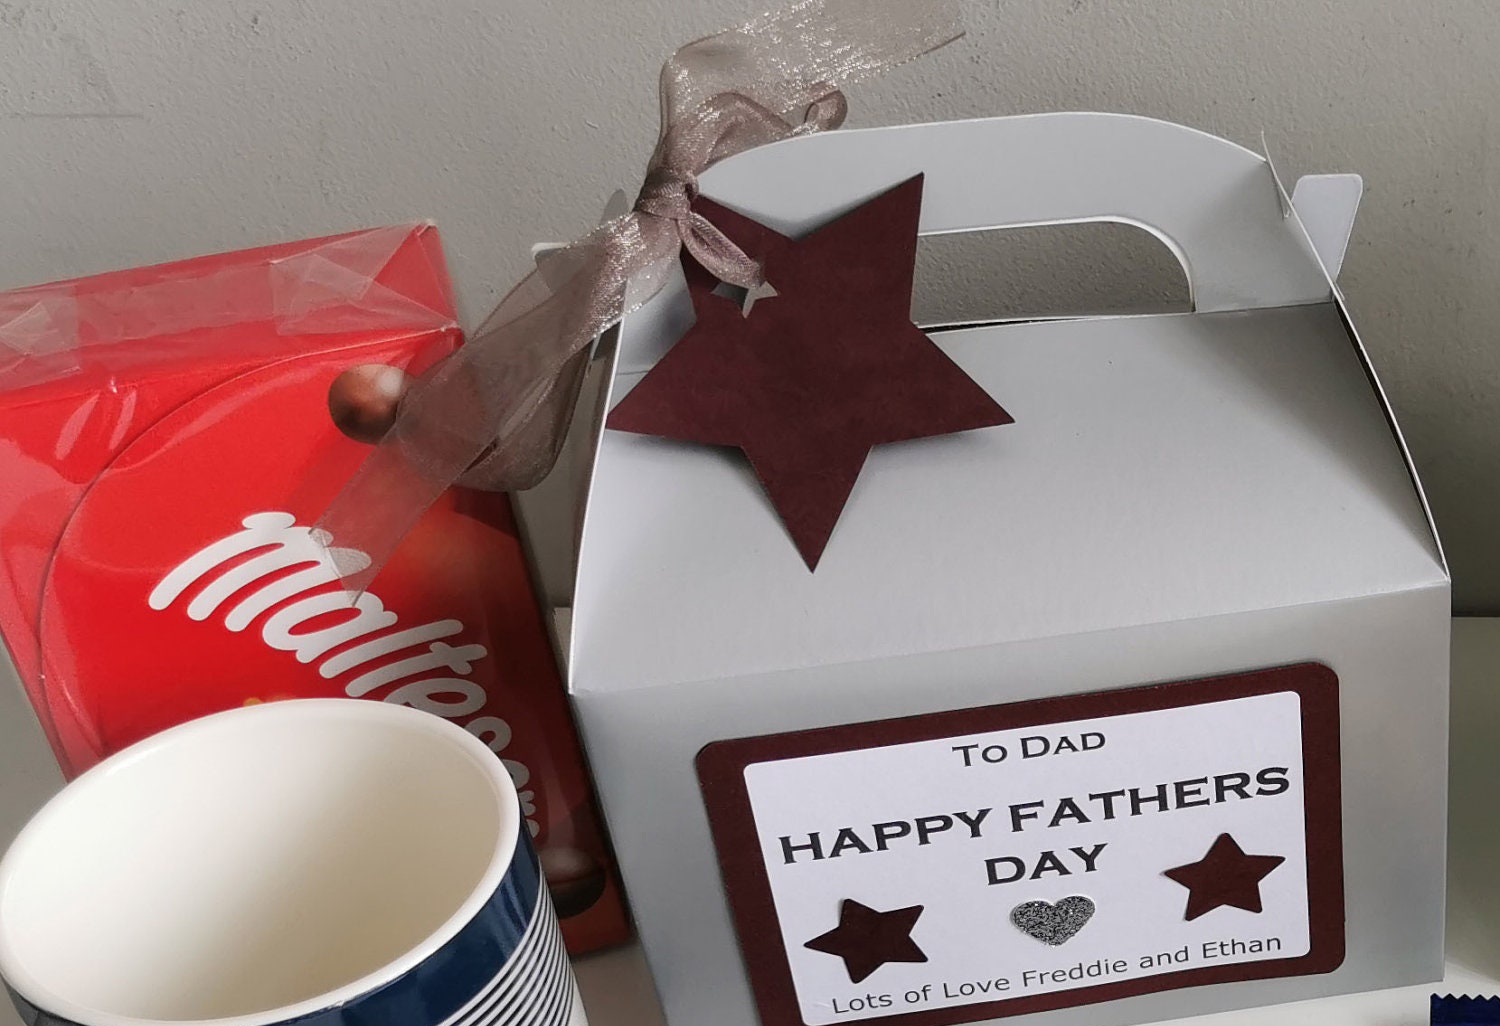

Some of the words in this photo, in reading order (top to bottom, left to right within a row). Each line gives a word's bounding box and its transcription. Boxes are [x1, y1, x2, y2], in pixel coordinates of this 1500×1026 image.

[778, 807, 993, 865] HAPPY
[1009, 765, 1291, 833] FATHERS
[984, 842, 1109, 886] DAY
[831, 990, 894, 1015] Lots
[904, 983, 932, 1004] of
[943, 973, 1010, 999] Love
[1022, 957, 1129, 988] Freddie
[1139, 945, 1190, 969] and
[1202, 934, 1283, 960] Ethan
